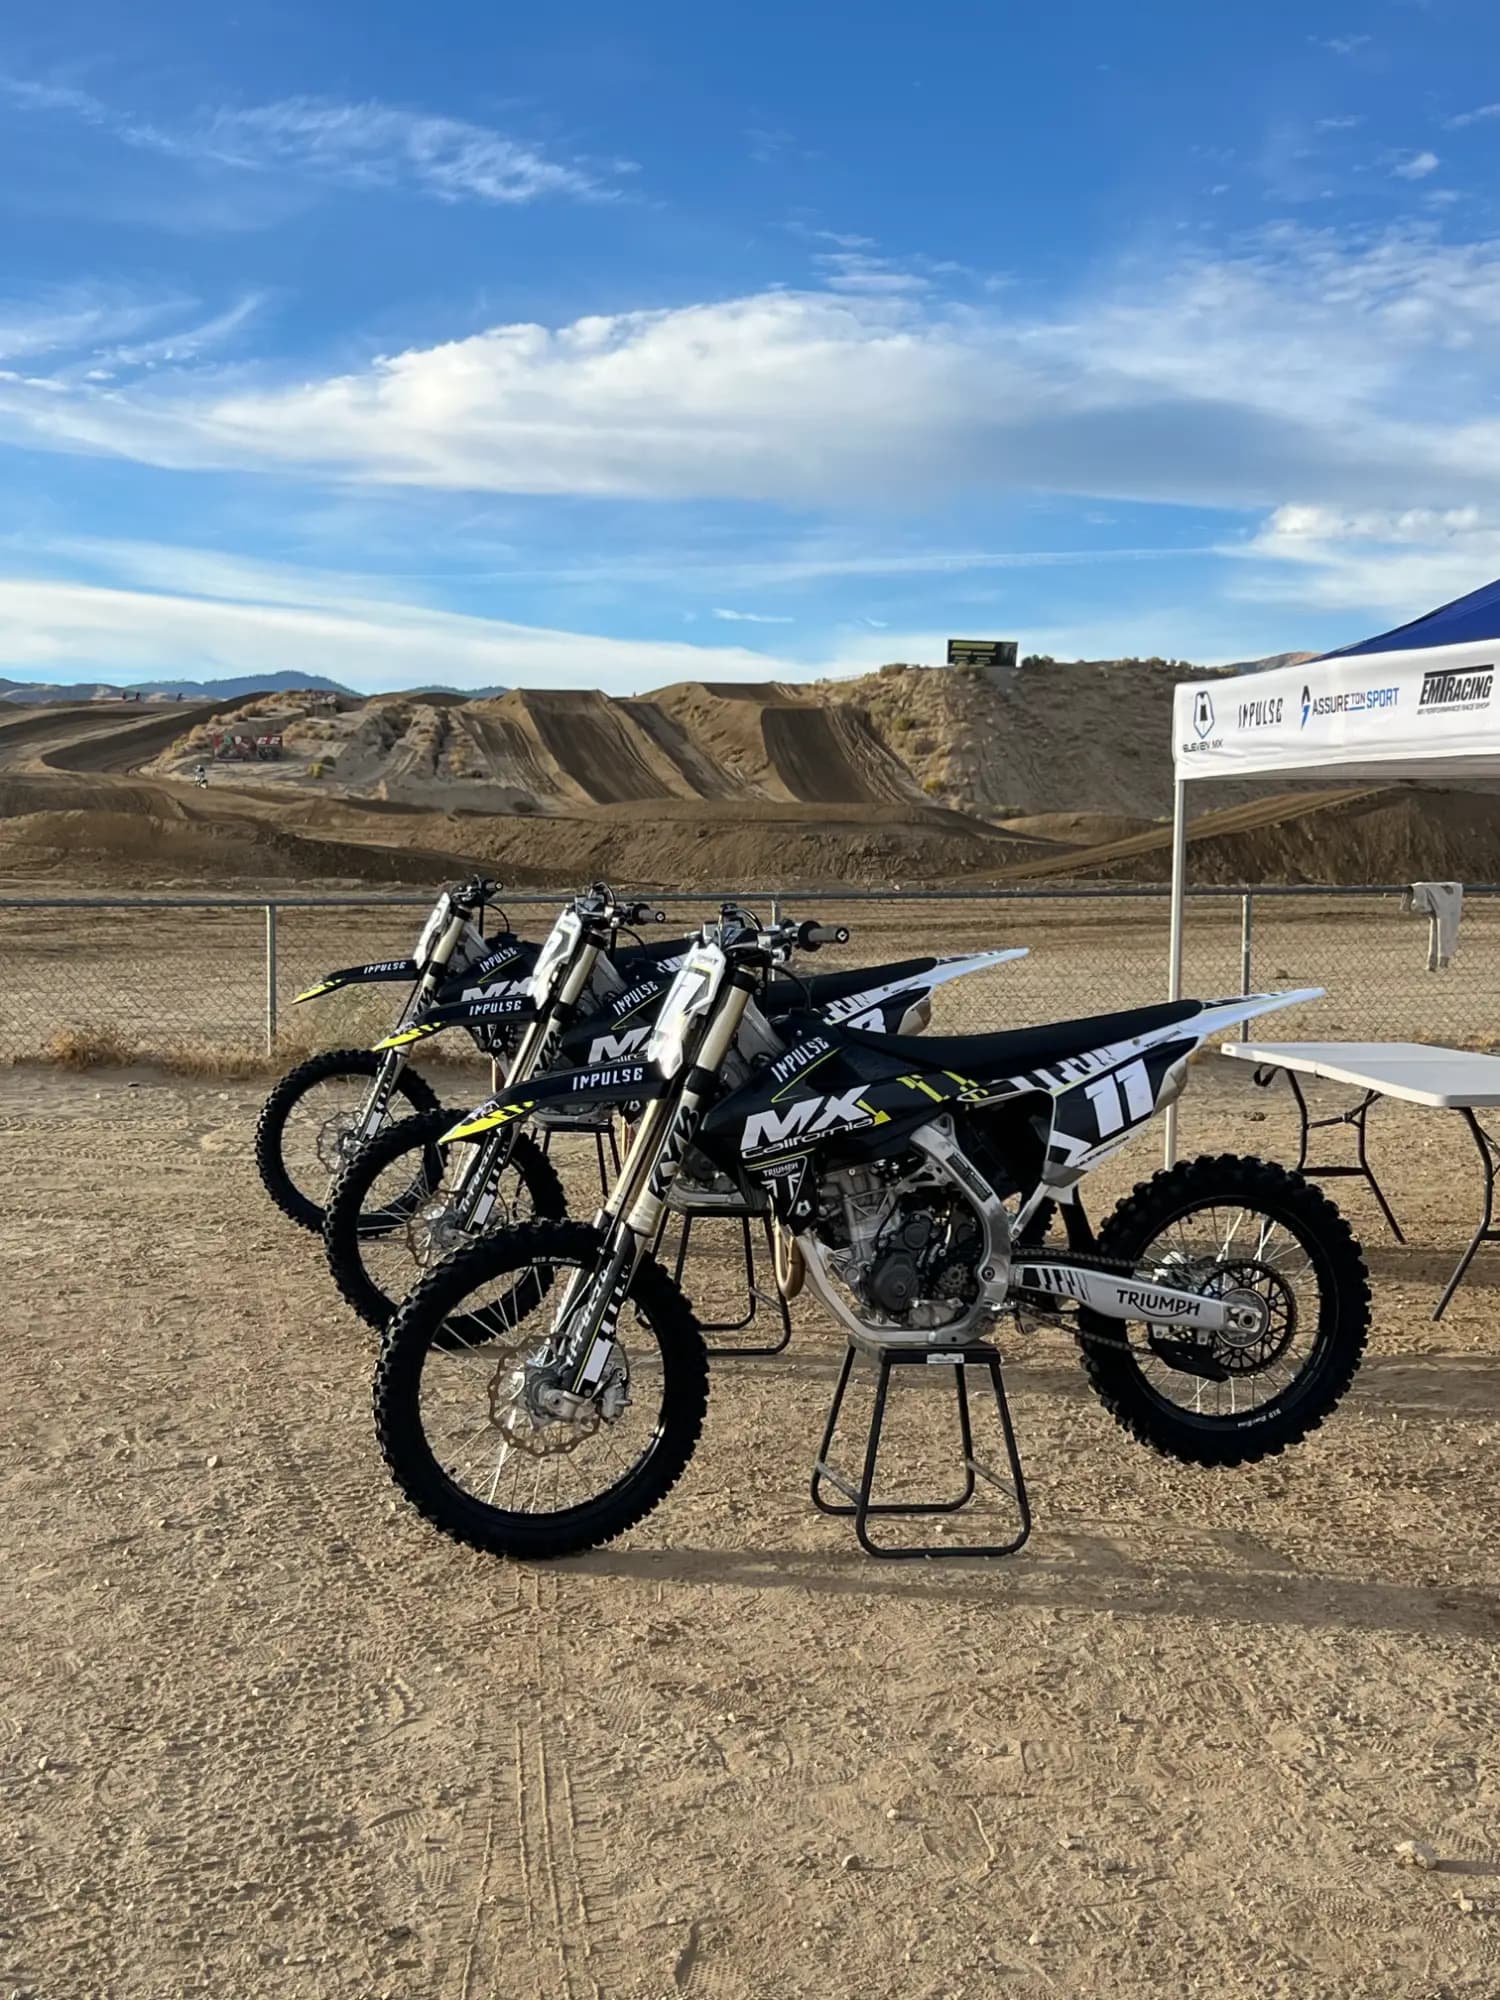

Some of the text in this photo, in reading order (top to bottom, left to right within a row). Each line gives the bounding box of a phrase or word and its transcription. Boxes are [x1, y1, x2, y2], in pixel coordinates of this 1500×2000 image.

[1238, 698, 1283, 728] IMPULSE
[363, 961, 407, 975] IMPULSE
[479, 946, 518, 973] IMPULSE
[469, 1000, 522, 1016] IMPULSE
[612, 980, 659, 1016] IMPULSE
[771, 1036, 830, 1083] IMPULSE
[572, 1067, 644, 1091] IMPULSE
[1084, 1058, 1154, 1138] 11
[740, 1084, 872, 1150] MX
[762, 1162, 799, 1177] TRIUMPH
[1116, 1289, 1201, 1318] TRIUMPH
